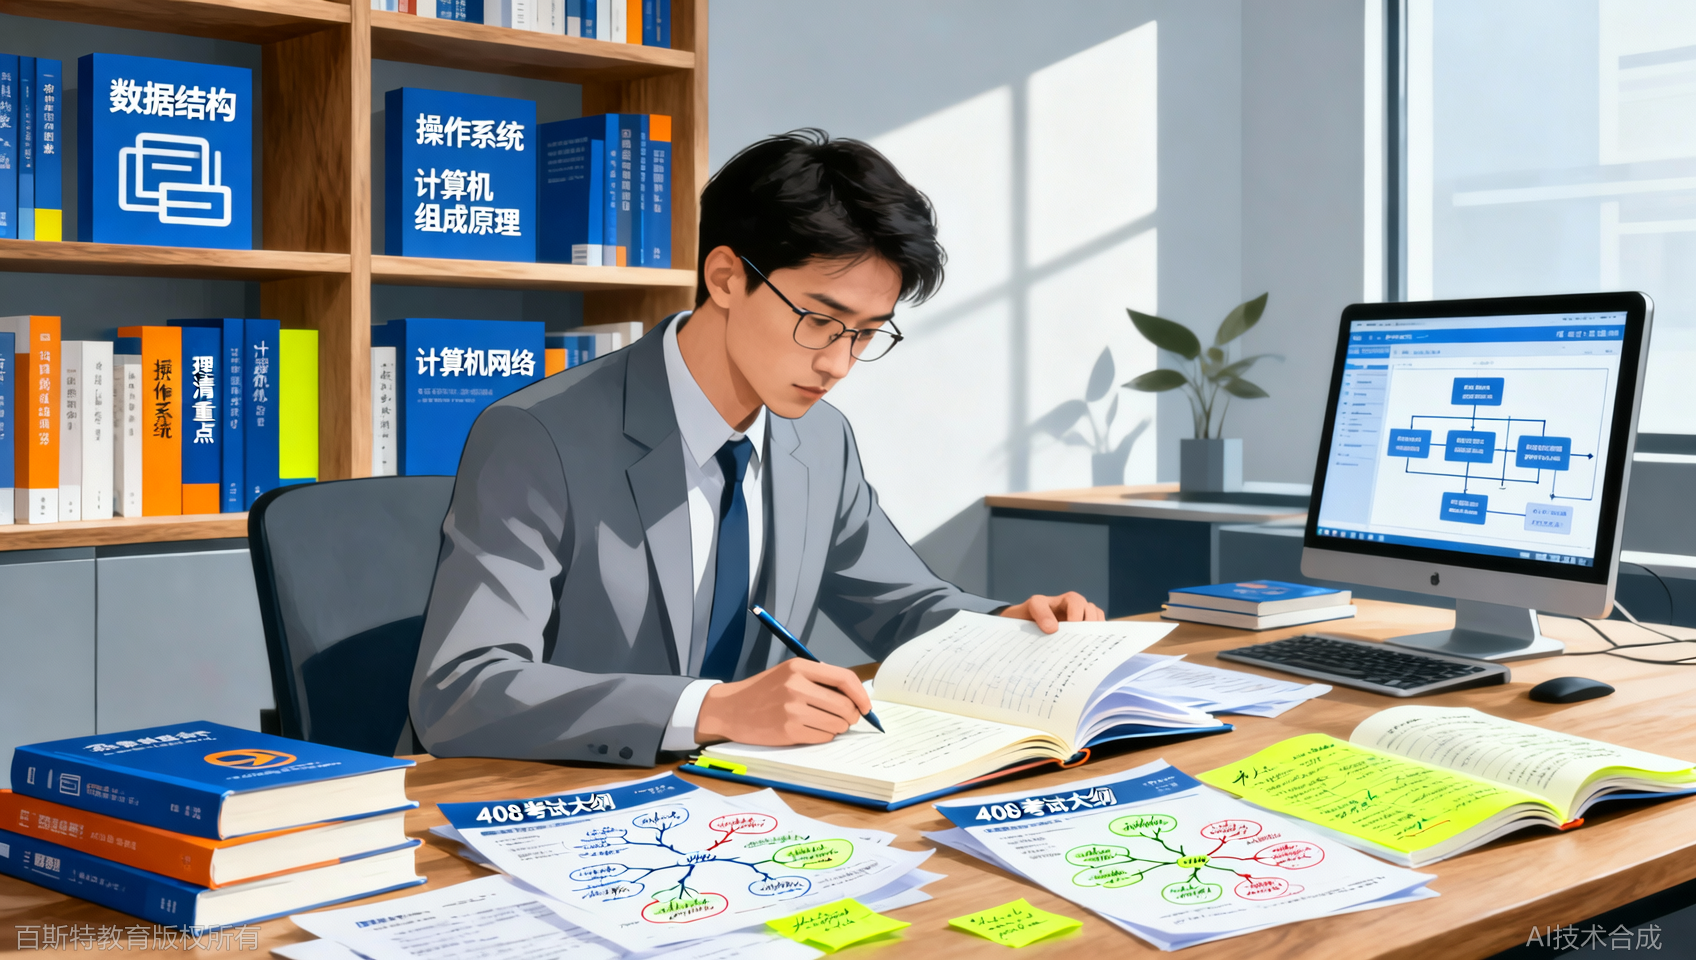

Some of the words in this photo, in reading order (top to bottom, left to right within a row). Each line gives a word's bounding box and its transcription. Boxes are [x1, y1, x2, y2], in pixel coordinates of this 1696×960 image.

[109, 78, 237, 122] 数据结构
[416, 113, 525, 151] 操作系统
[414, 168, 494, 202] 计算机
[414, 202, 522, 236] 组成原理
[415, 347, 536, 377] 计算机网络
[192, 356, 216, 444] 理清重点
